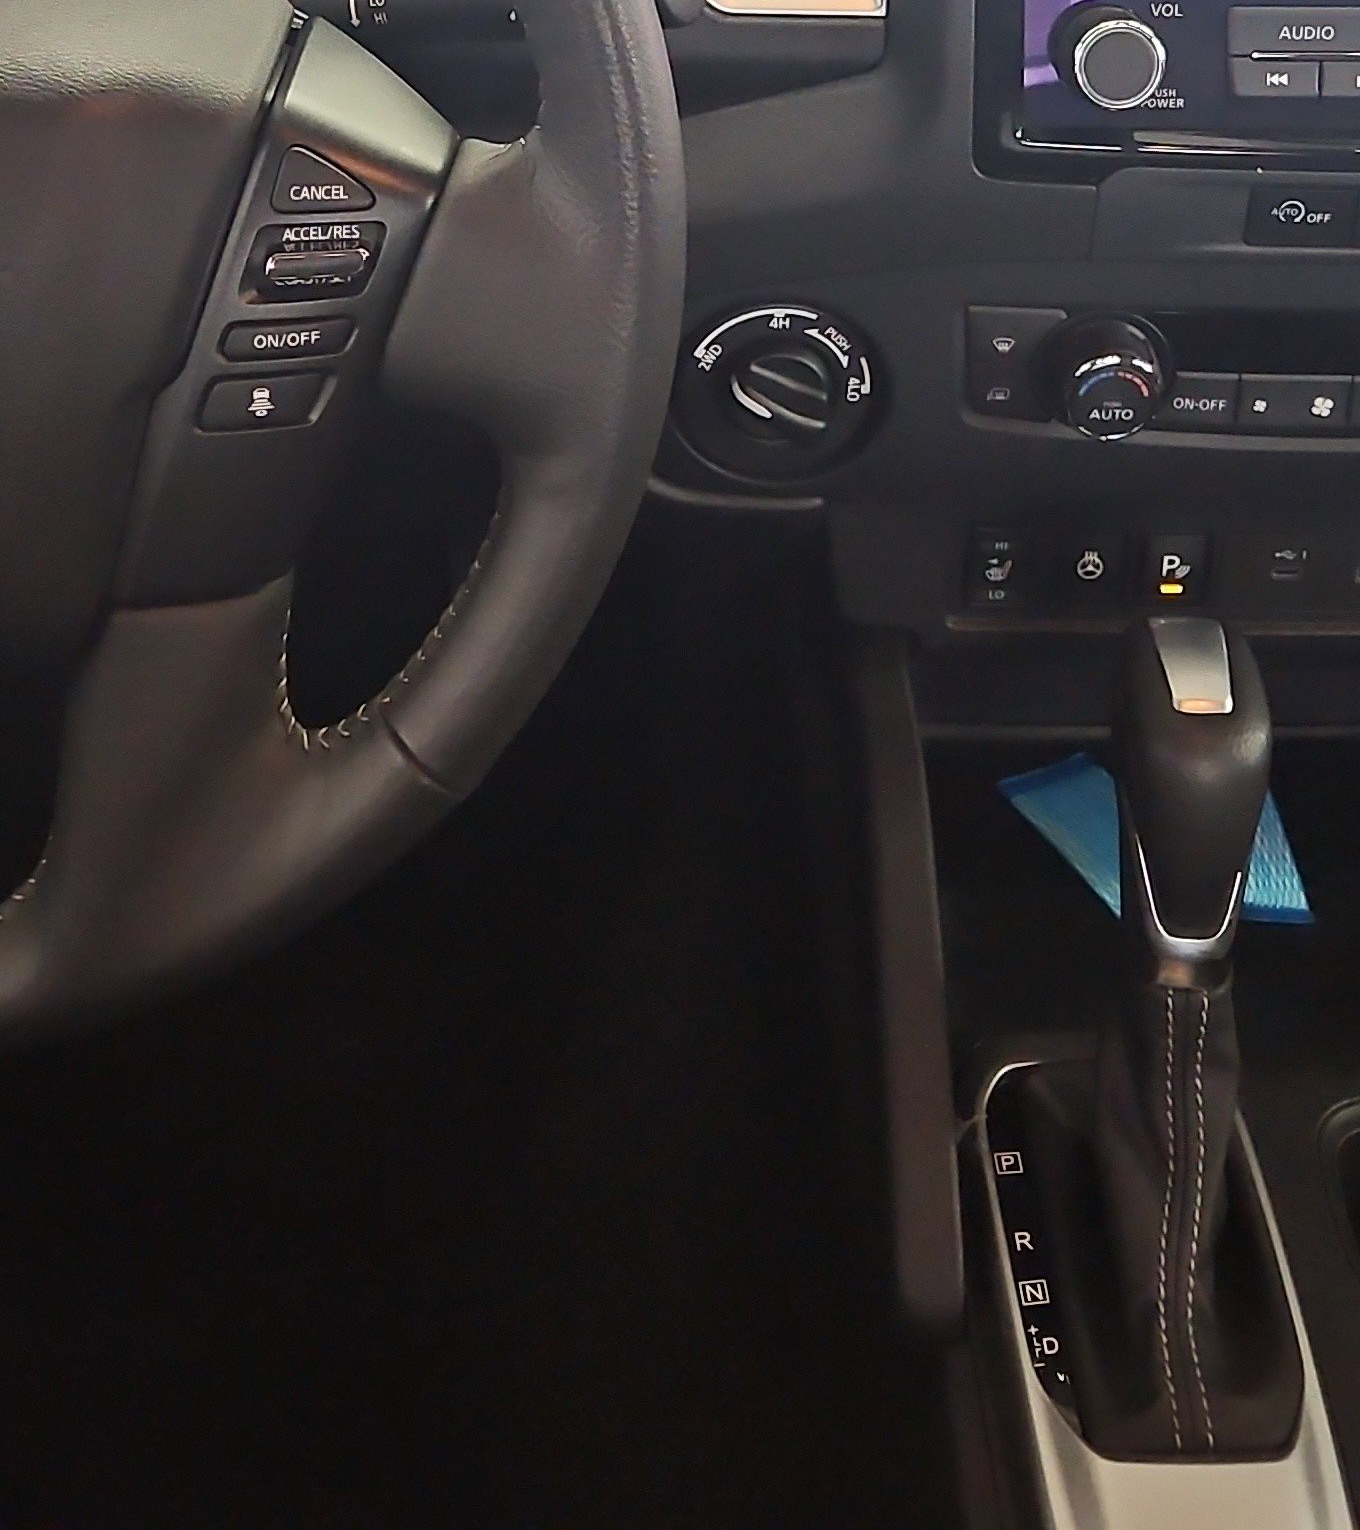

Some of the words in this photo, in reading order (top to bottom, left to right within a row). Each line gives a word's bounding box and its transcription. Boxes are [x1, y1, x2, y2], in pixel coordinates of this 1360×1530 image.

[373, 12, 388, 25] HI
[1150, 2, 1184, 18] VOL
[1278, 25, 1336, 41] AUDIO
[1153, 88, 1177, 98] USH
[289, 184, 349, 202] CANCEL
[1306, 212, 1332, 225] OFF
[281, 224, 361, 242] ACCEL/RES
[768, 317, 791, 330] 4H
[252, 330, 322, 350] ON/OFF
[823, 326, 852, 352] PUSH
[698, 343, 724, 372] 2WD
[846, 376, 862, 403] 4LO
[1088, 408, 1135, 421] AUTO
[988, 589, 1006, 601] LO
[1000, 1155, 1016, 1172] P
[1013, 1231, 1034, 1252] R
[1025, 1282, 1044, 1302] N
[1042, 1336, 1060, 1356] D
